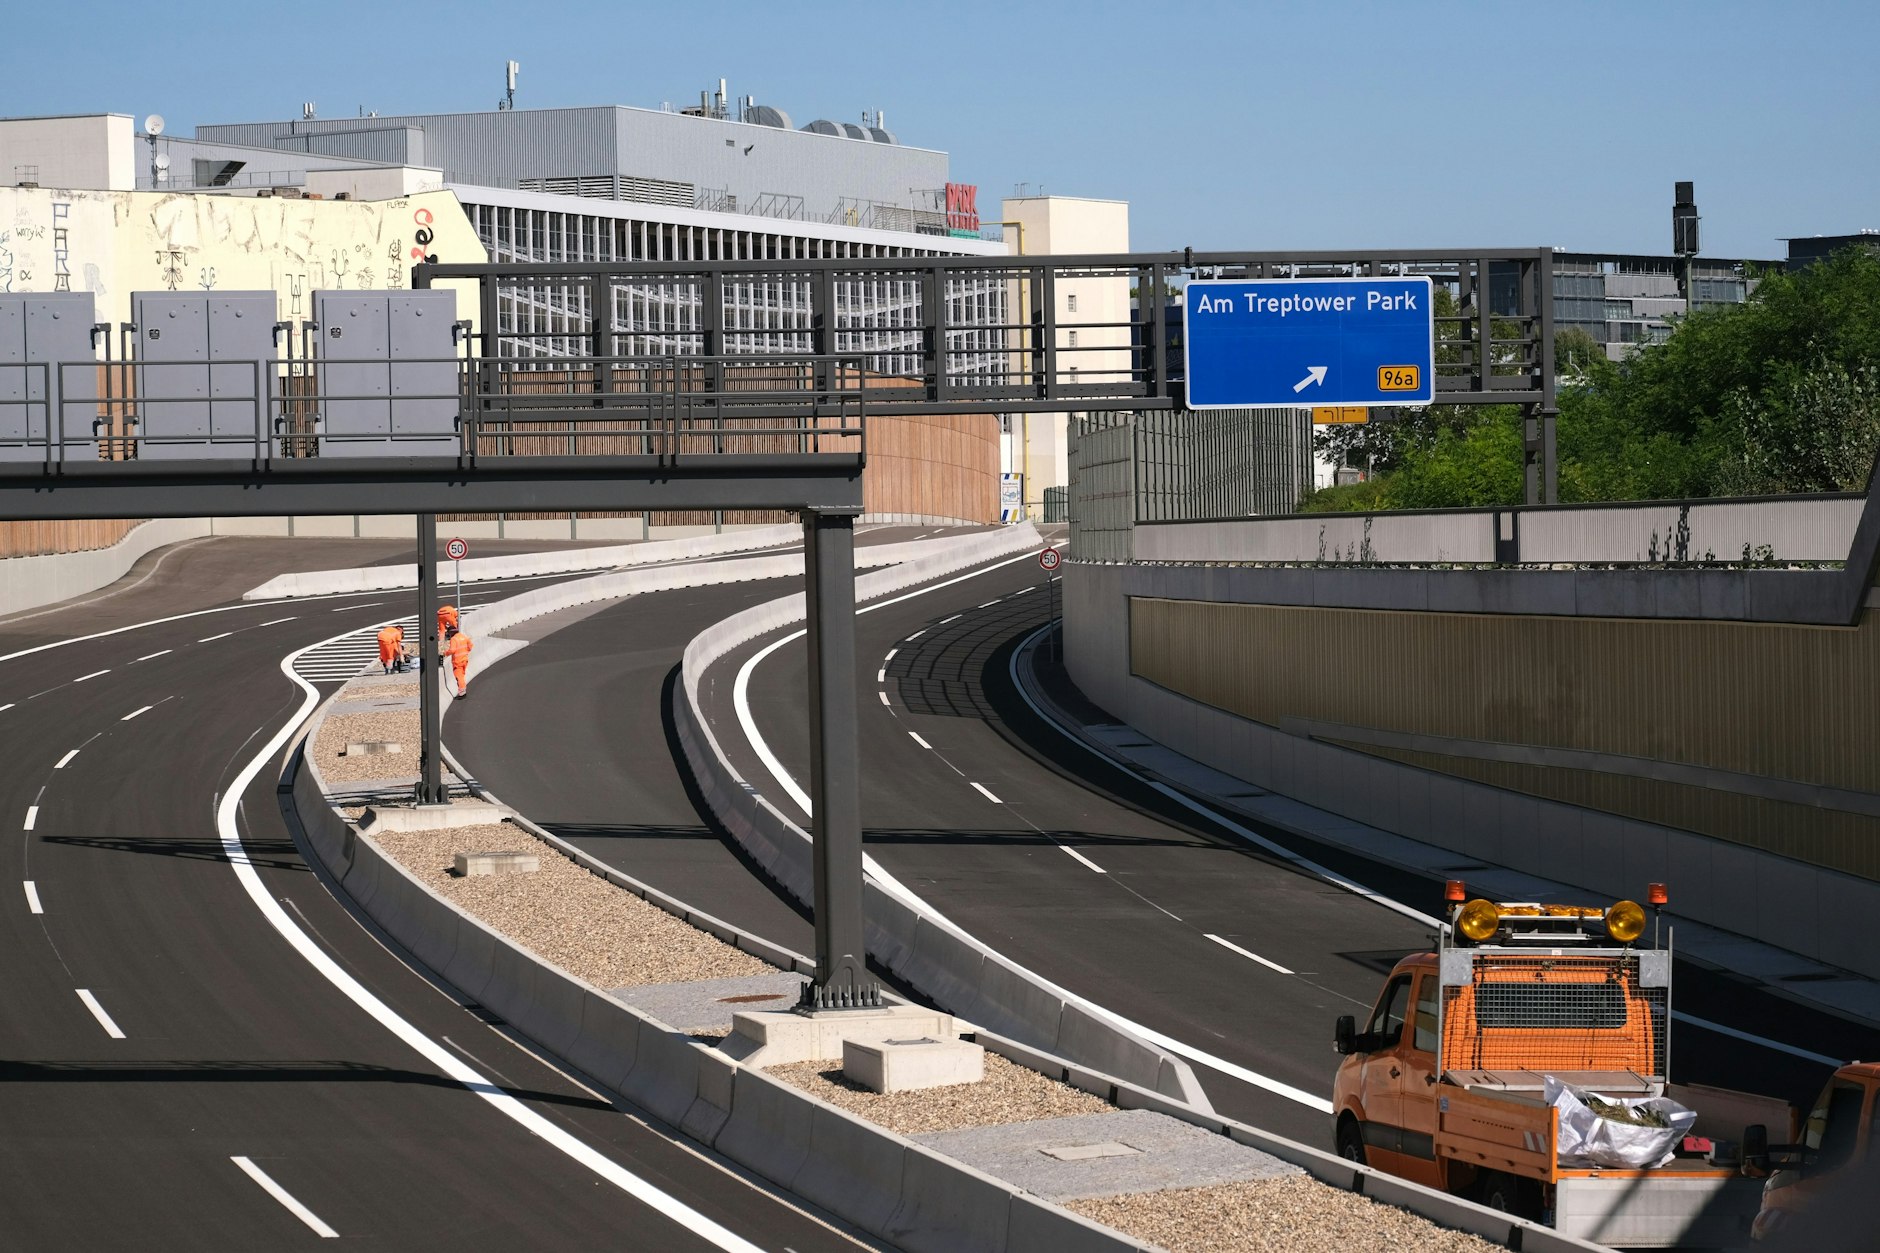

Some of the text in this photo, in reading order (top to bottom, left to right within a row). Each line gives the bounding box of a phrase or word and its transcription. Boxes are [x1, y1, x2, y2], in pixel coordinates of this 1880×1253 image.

[946, 183, 977, 214] PARK
[1197, 291, 1417, 317] Am Treptower Park
[1384, 371, 1414, 386] 96a
[451, 544, 463, 554] 50
[1043, 554, 1056, 564] 50
